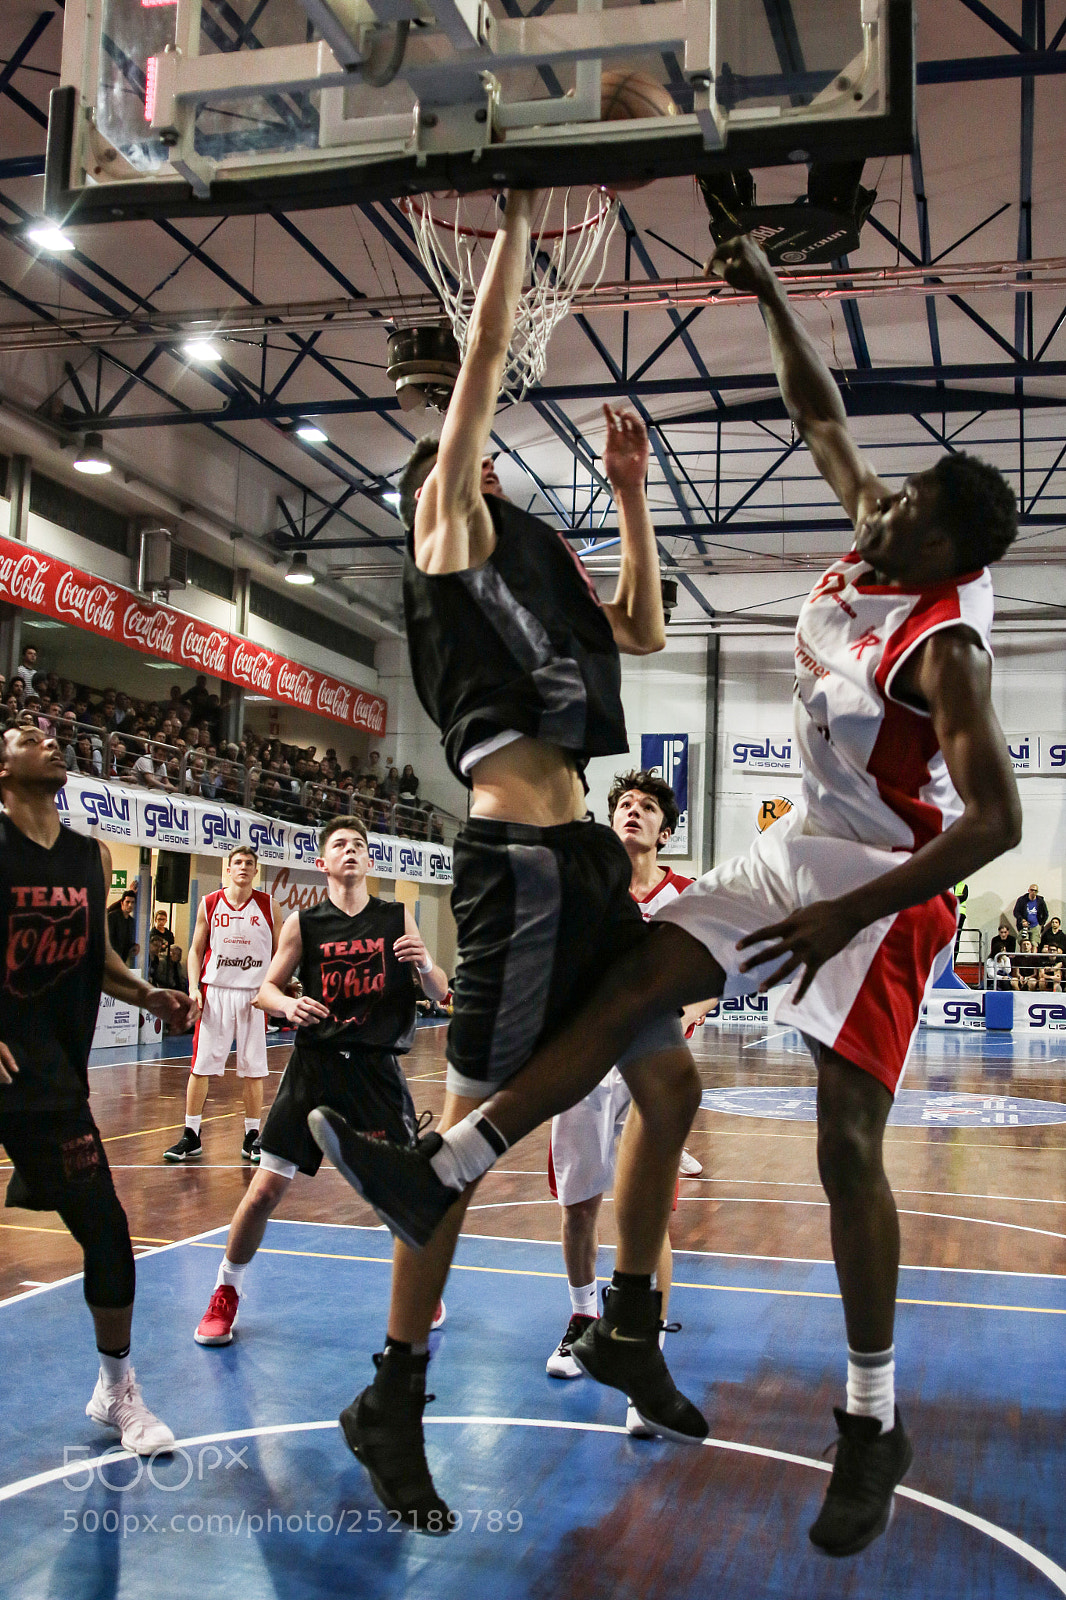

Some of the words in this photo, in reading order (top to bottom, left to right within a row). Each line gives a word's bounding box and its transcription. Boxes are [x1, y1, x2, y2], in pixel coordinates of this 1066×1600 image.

[733, 738, 791, 763] galvi
[748, 760, 791, 768] LISSONE
[80, 785, 130, 825] galvi
[144, 797, 189, 837] galvi
[100, 822, 131, 836] LISSONE
[202, 807, 241, 845] galvi
[249, 820, 285, 852] galvi
[158, 833, 189, 845] LISSONE
[213, 841, 239, 851] LISSO
[11, 886, 88, 907] TEAM
[6, 925, 88, 971] Ohio
[320, 937, 384, 957] TEAM
[322, 967, 385, 1003] Ohio
